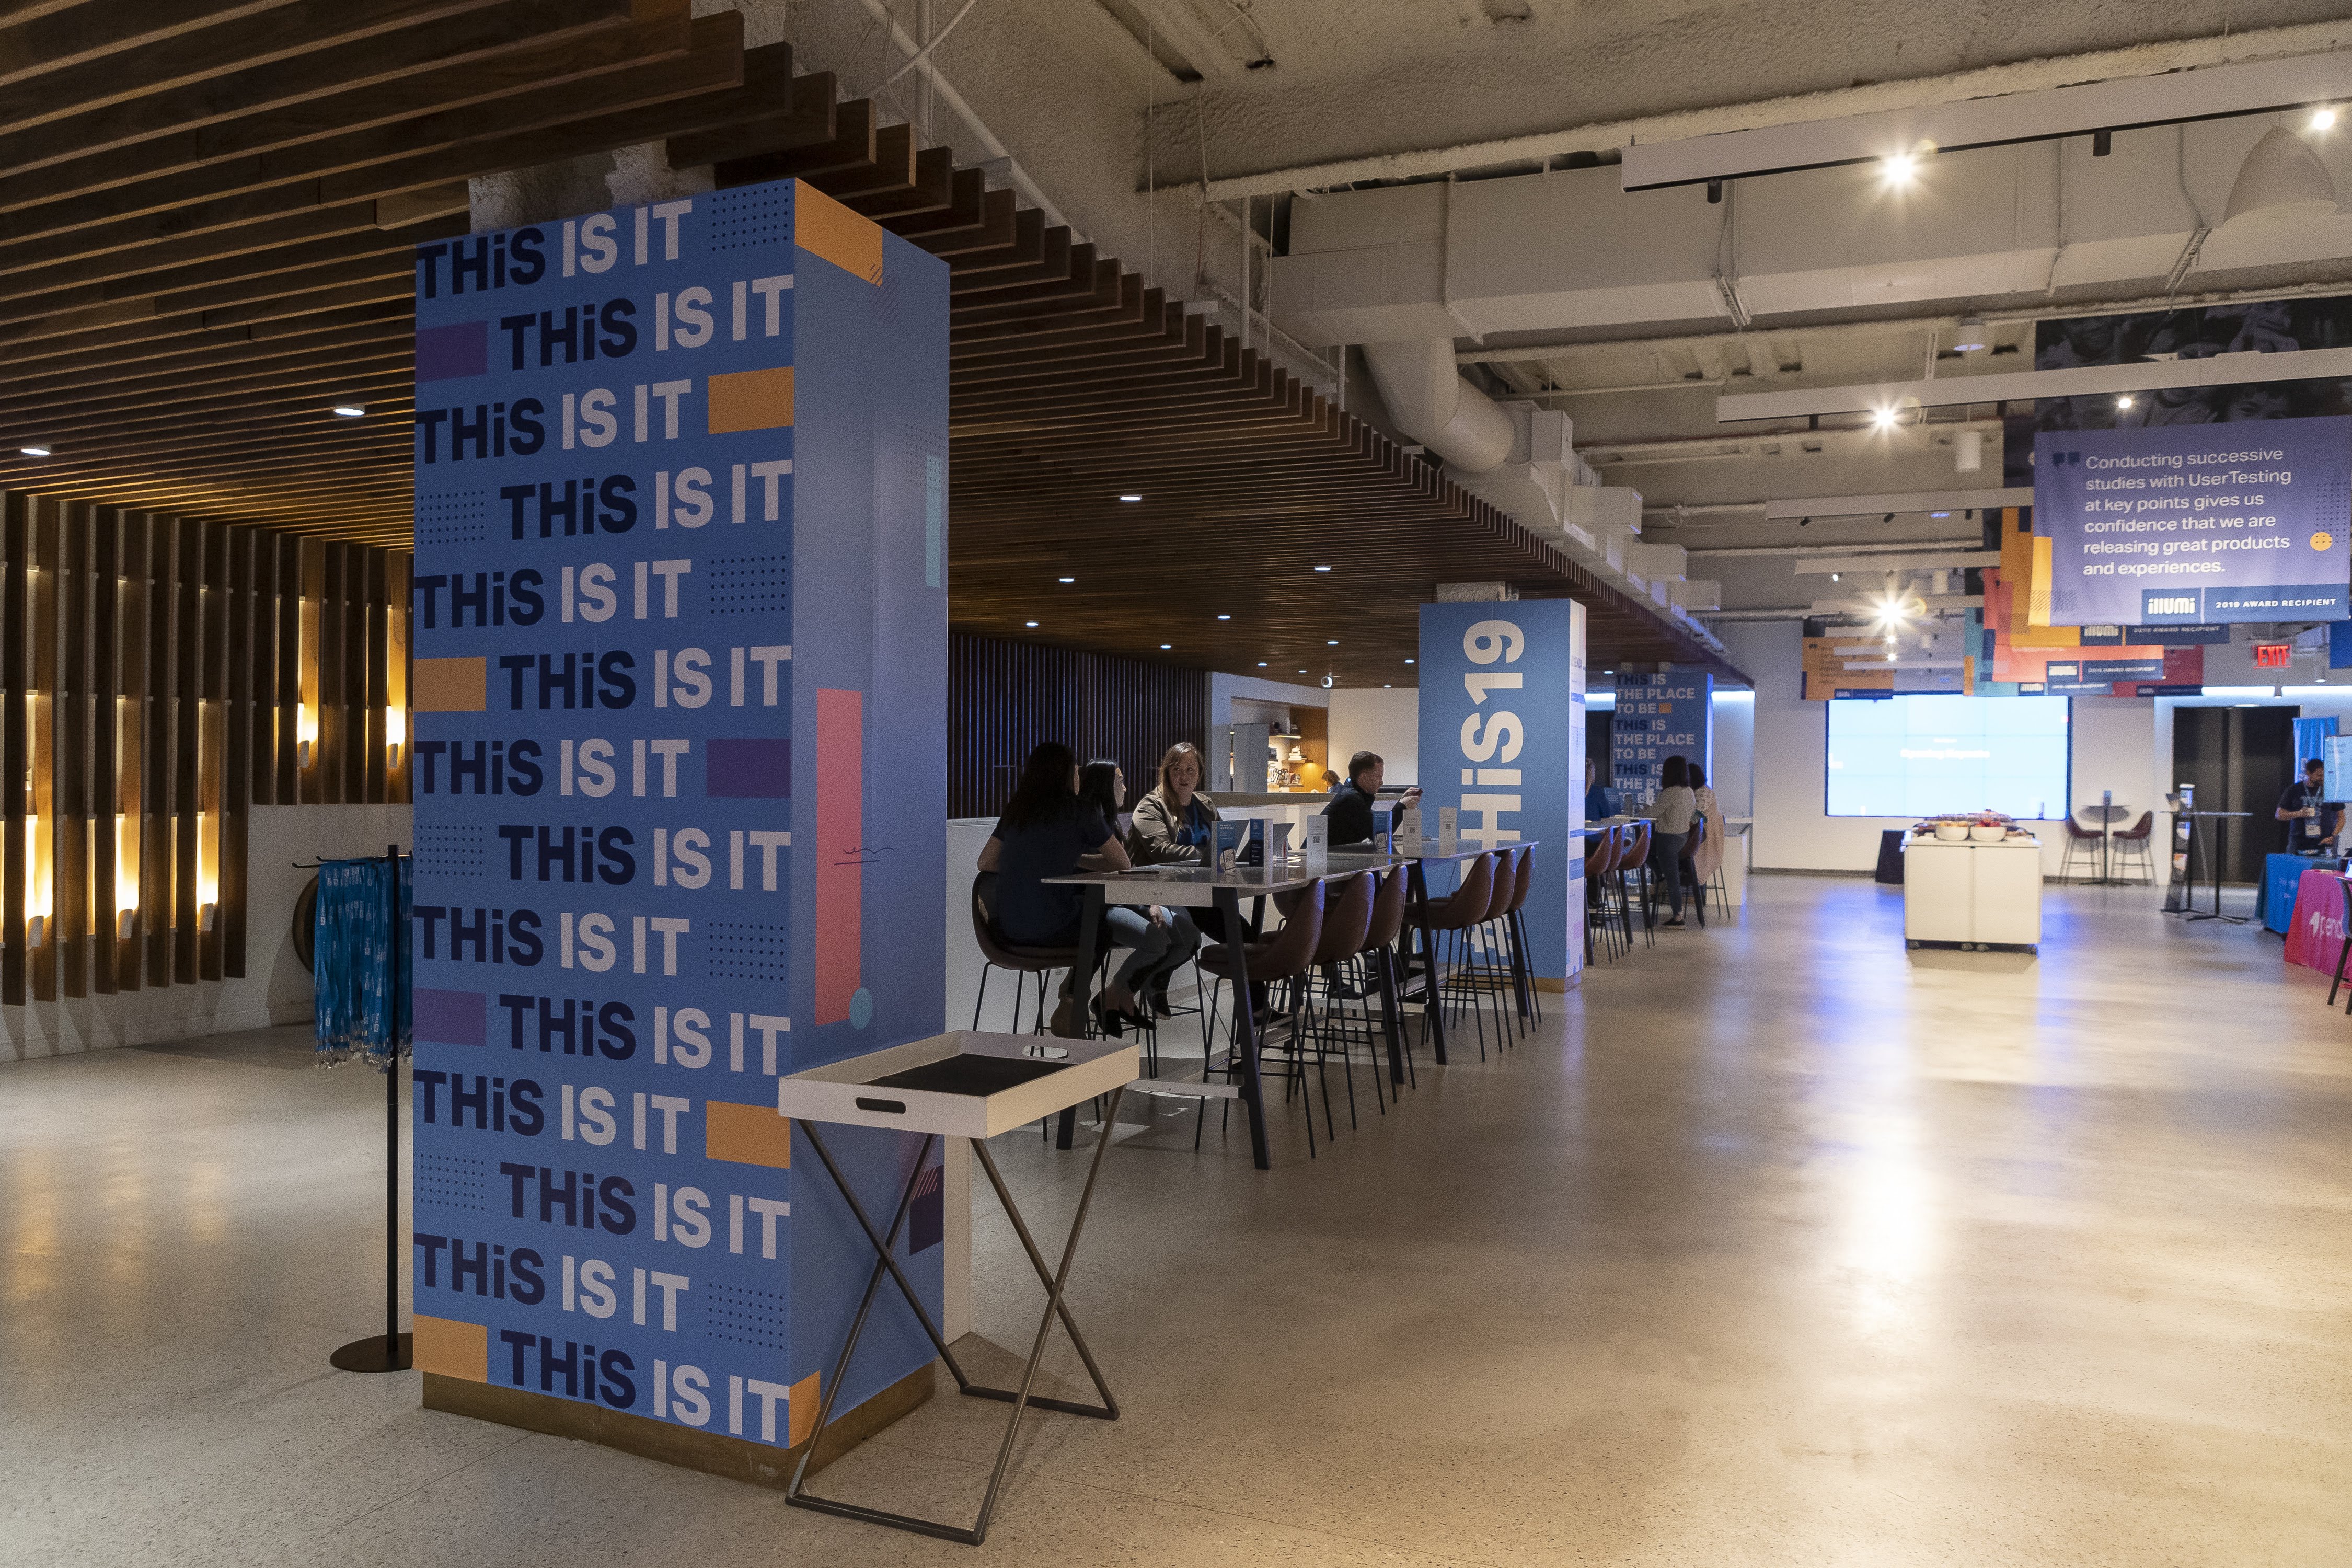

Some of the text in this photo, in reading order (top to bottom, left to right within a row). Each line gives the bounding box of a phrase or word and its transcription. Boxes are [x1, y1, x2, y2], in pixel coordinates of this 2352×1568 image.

[414, 200, 692, 299] THiS IS IT
[500, 275, 794, 371] THiS IS IT
[414, 379, 691, 464] THiS IS IT
[2086, 447, 2283, 469] Conducting successive
[2086, 476, 2146, 490] studies
[2150, 475, 2184, 488] with
[500, 460, 793, 539] THiS IS IT
[2085, 494, 2264, 513] at key points gives us
[2084, 516, 2276, 533] confidence that we are
[2084, 536, 2290, 556] releasing great products
[2083, 561, 2226, 577] and experiences.
[414, 560, 690, 629] THiS IS IT
[2242, 599, 2278, 608] AWARD
[2281, 598, 2336, 607] RECIPIENT
[2257, 645, 2289, 666] EXIT
[501, 646, 792, 709] THiS IS IT
[1652, 674, 1666, 685] IS
[1615, 688, 1695, 699] THE PLACE
[1615, 703, 1656, 714] TO BE
[1651, 719, 1666, 731] IS
[1615, 734, 1695, 745] THE PLACE
[1615, 748, 1656, 759] TO BE
[414, 739, 689, 797] THiS IS IT
[1614, 778, 1642, 789] THE
[499, 826, 791, 891] THiS IS IT
[414, 906, 544, 967] THiS
[561, 913, 615, 971] IS
[633, 917, 689, 975] IT
[500, 995, 791, 1075] THiS IS IT
[414, 1071, 689, 1154] THiS IS IT
[501, 1163, 791, 1259] THiS IS IT
[414, 1236, 688, 1331] THiS IS IT
[501, 1330, 790, 1442] THiS IS IT
